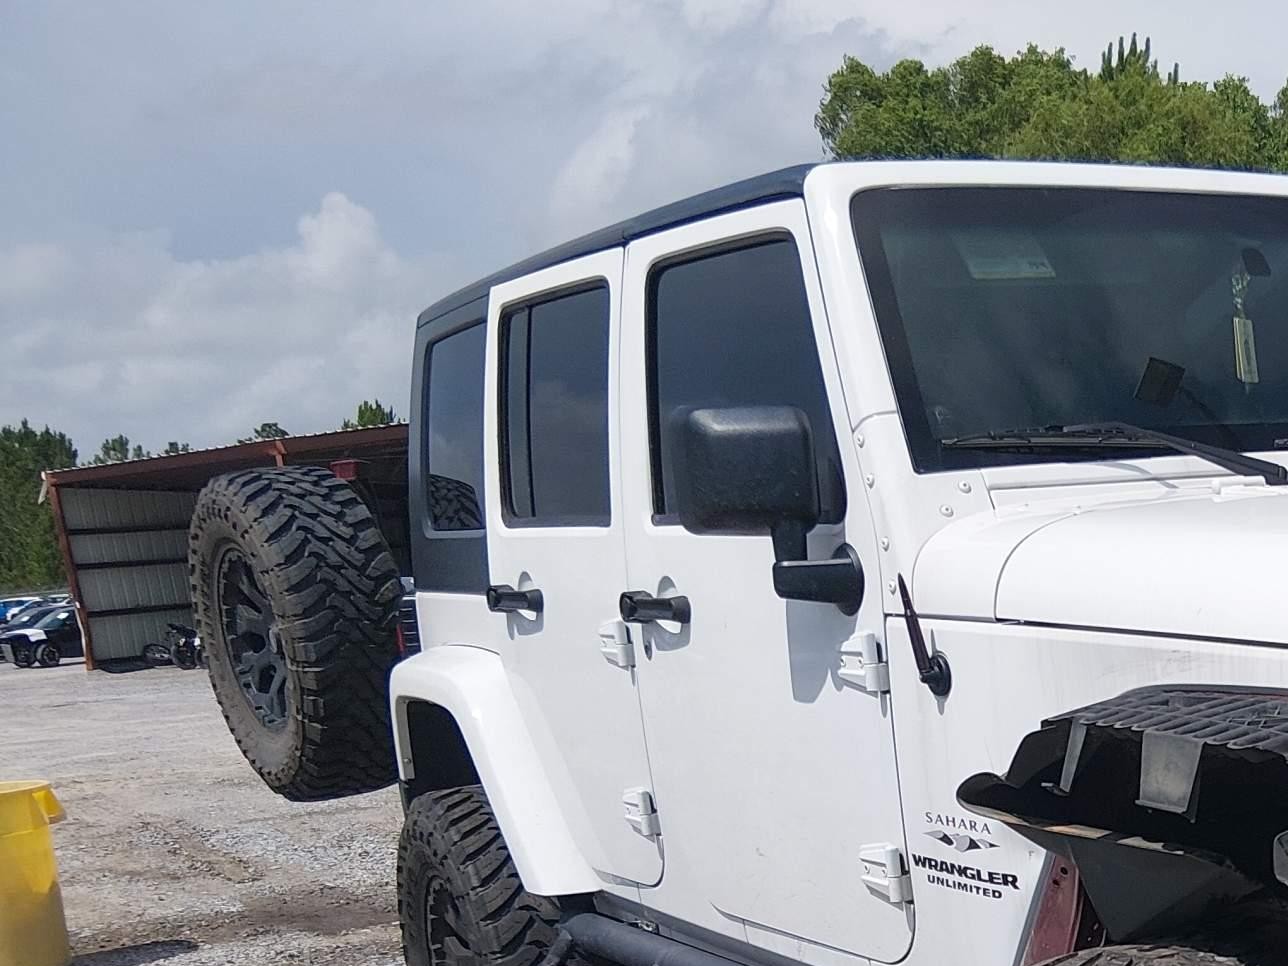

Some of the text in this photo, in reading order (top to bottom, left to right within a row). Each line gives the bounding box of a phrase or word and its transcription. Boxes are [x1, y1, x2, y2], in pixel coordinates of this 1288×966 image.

[925, 811, 991, 834] SAHARA
[911, 853, 1021, 891] WRANGLER
[927, 874, 1003, 899] UNLIMITED
